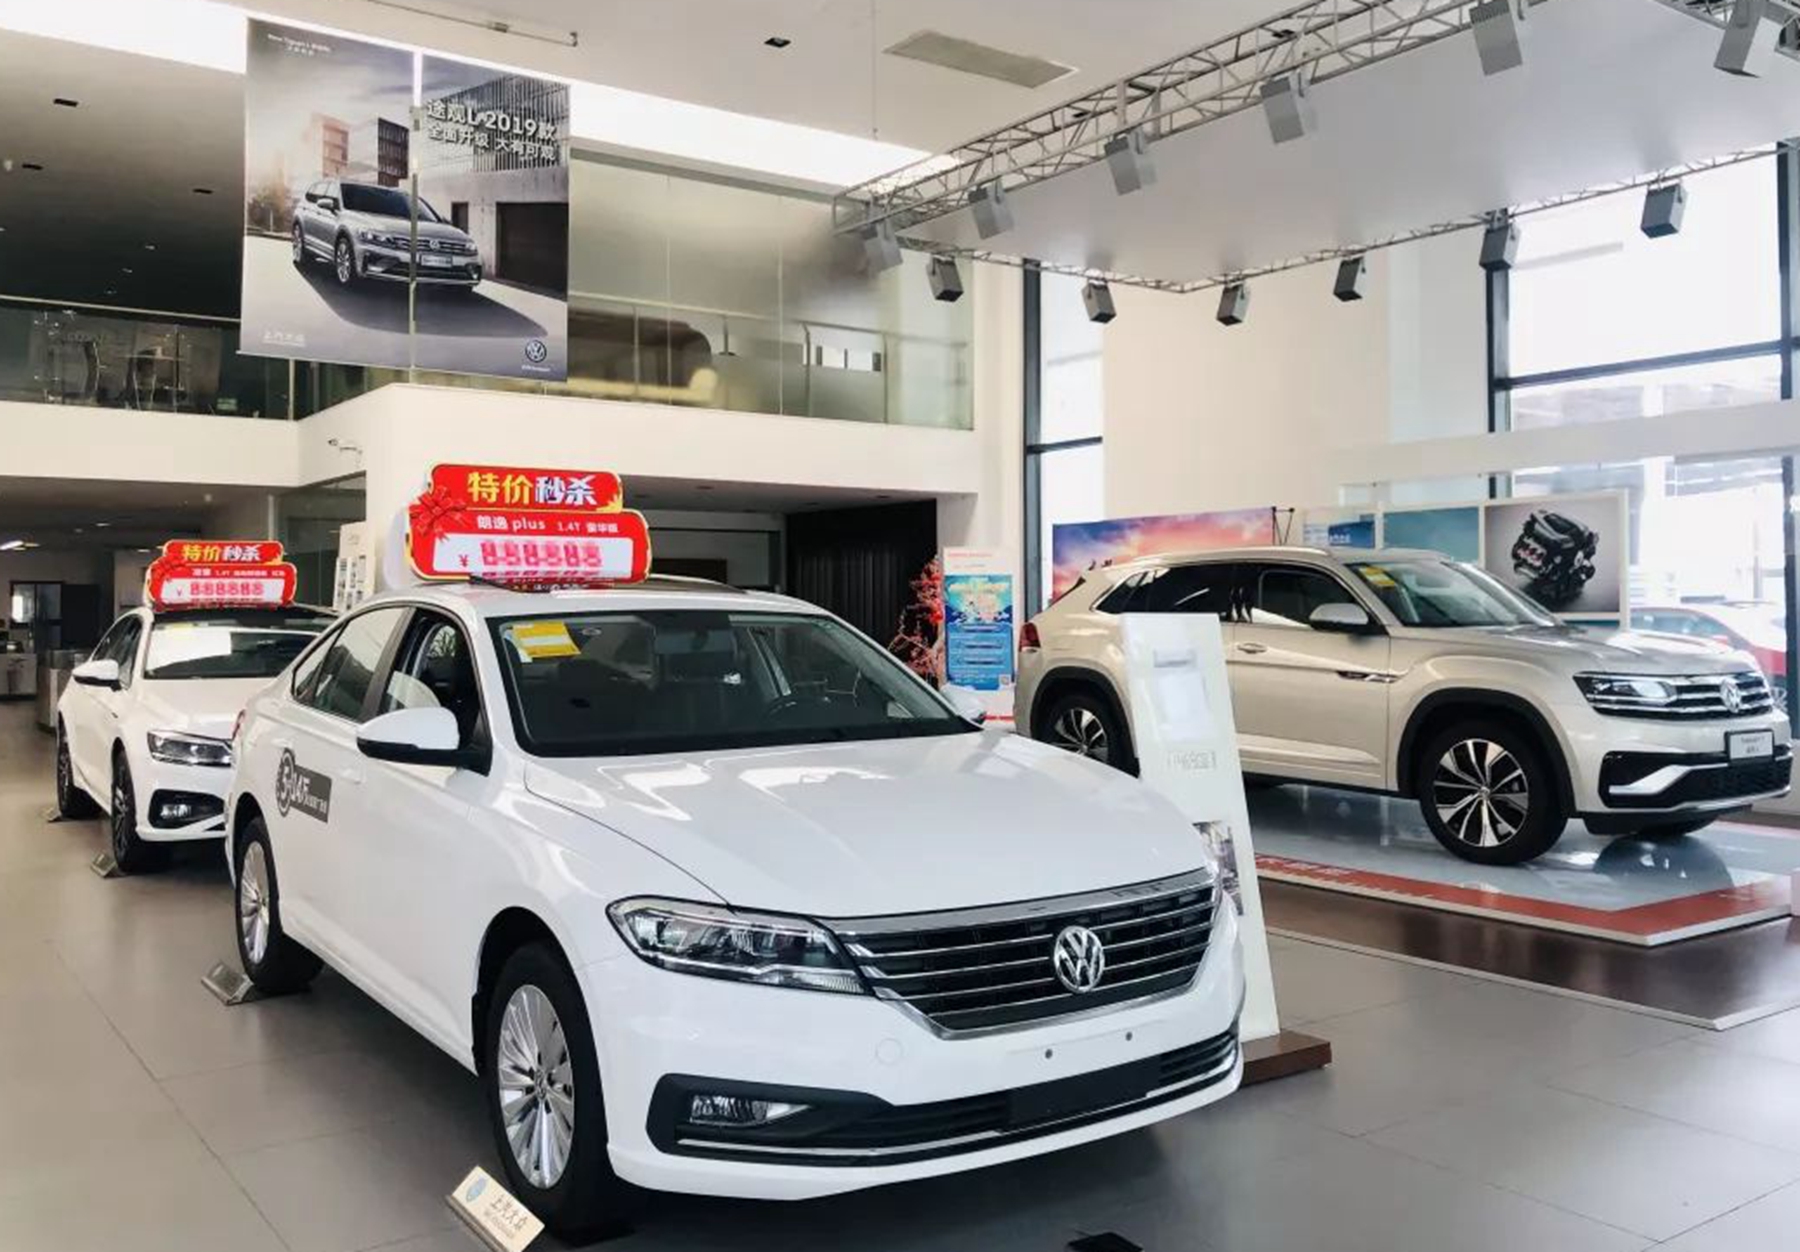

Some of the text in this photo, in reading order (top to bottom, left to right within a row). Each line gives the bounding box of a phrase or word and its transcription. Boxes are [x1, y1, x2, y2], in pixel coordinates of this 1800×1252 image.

[485, 110, 556, 140] 2019款
[467, 472, 598, 505] 特价秒杀
[512, 515, 546, 532] plus
[182, 543, 260, 562] 特价秒杀
